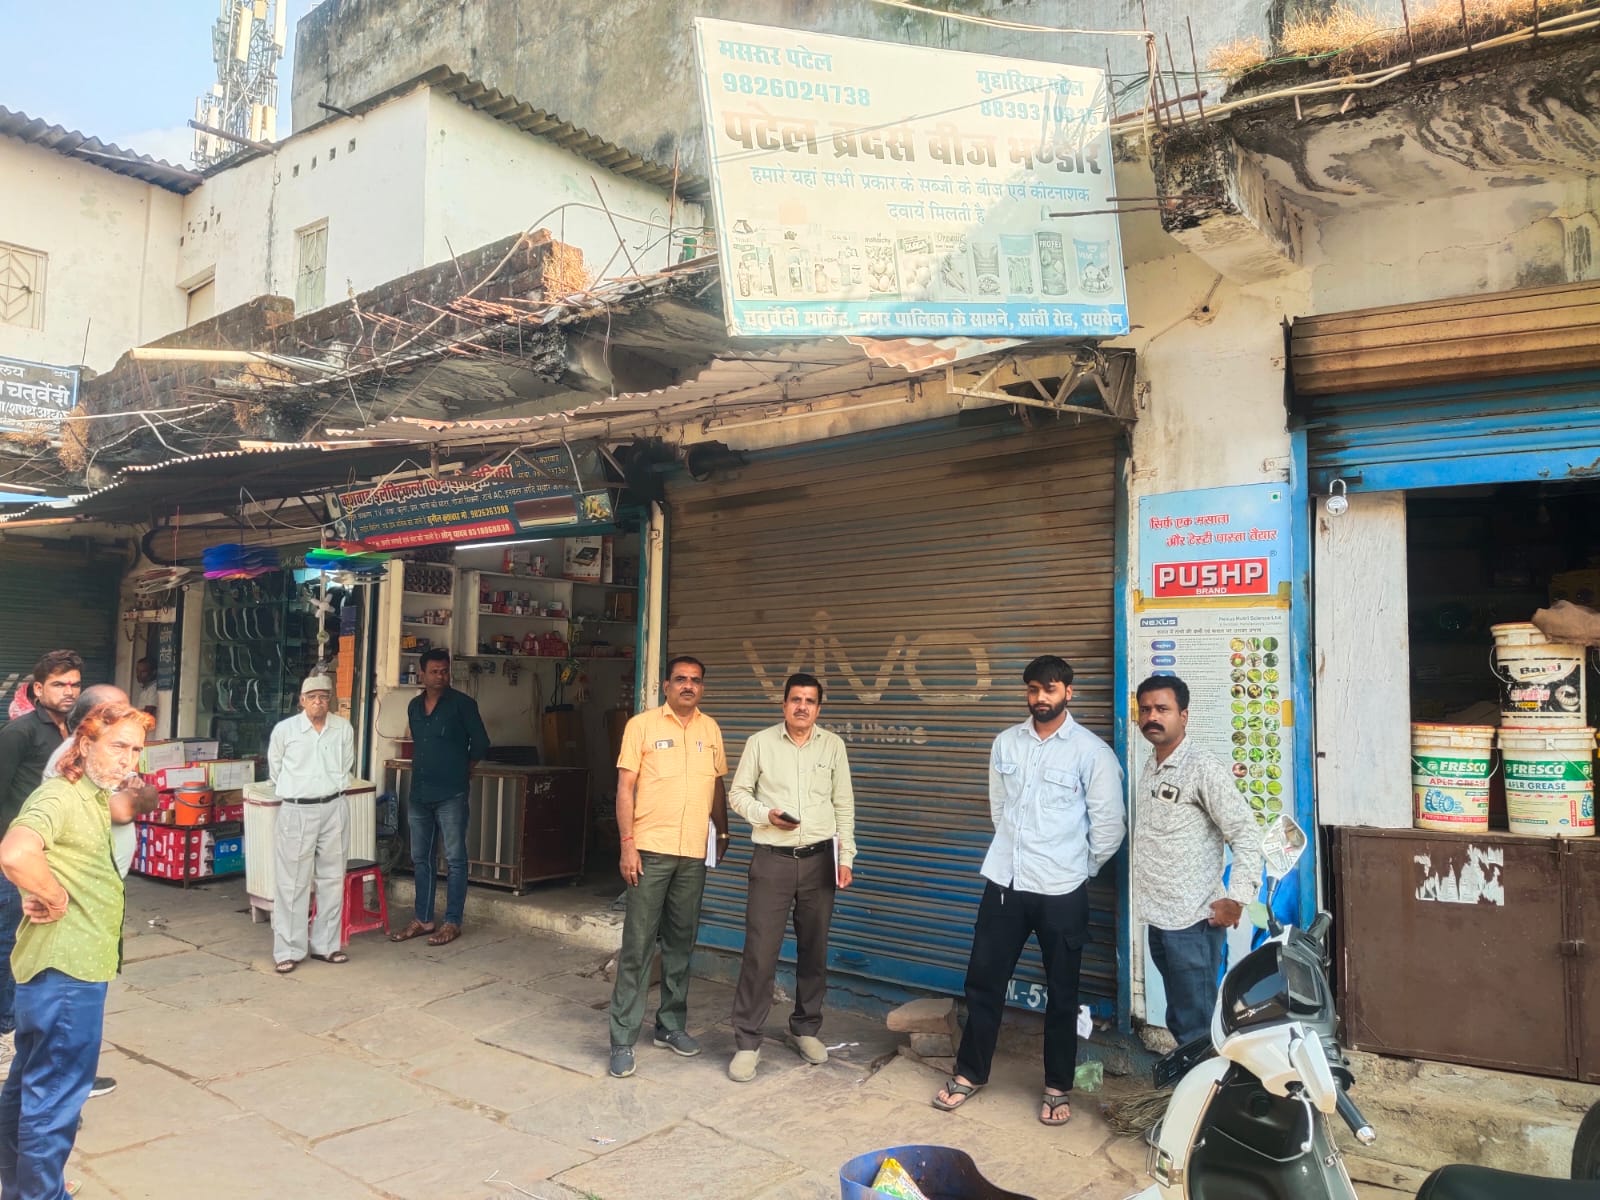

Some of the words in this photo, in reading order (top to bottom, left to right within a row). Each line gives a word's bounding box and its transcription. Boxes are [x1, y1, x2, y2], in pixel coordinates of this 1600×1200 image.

[784, 44, 833, 73] पटेल
[721, 72, 872, 108] 9826024738
[721, 101, 819, 156] पटेल
[924, 122, 998, 168] बीज
[750, 163, 786, 186] हमारे
[821, 168, 855, 190] सभी
[860, 174, 897, 192] प्रकार
[898, 169, 915, 193] के
[918, 174, 954, 197] सब्जी
[957, 176, 972, 198] के
[1006, 179, 1027, 204] एवं
[1029, 182, 1090, 205] कीटनाशक
[928, 200, 972, 223] मिलती
[894, 308, 948, 330] पालिका
[951, 308, 967, 329] के
[1017, 308, 1050, 329] सांची
[1052, 311, 1078, 331] रोड,
[1080, 311, 1123, 330] रायसेन
[1150, 516, 1172, 530] सिर्फ
[1175, 517, 1193, 530] एक
[1196, 513, 1230, 526] मसाला
[1166, 534, 1185, 548] और
[1216, 532, 1245, 545] पास्ता
[1249, 528, 1277, 541] तैयार
[1159, 562, 1264, 589] PUSHP
[1196, 587, 1228, 596] BRAND
[1439, 761, 1487, 773] FRESCO
[1512, 764, 1566, 776] FRESCO
[1527, 782, 1567, 790] GREASE
